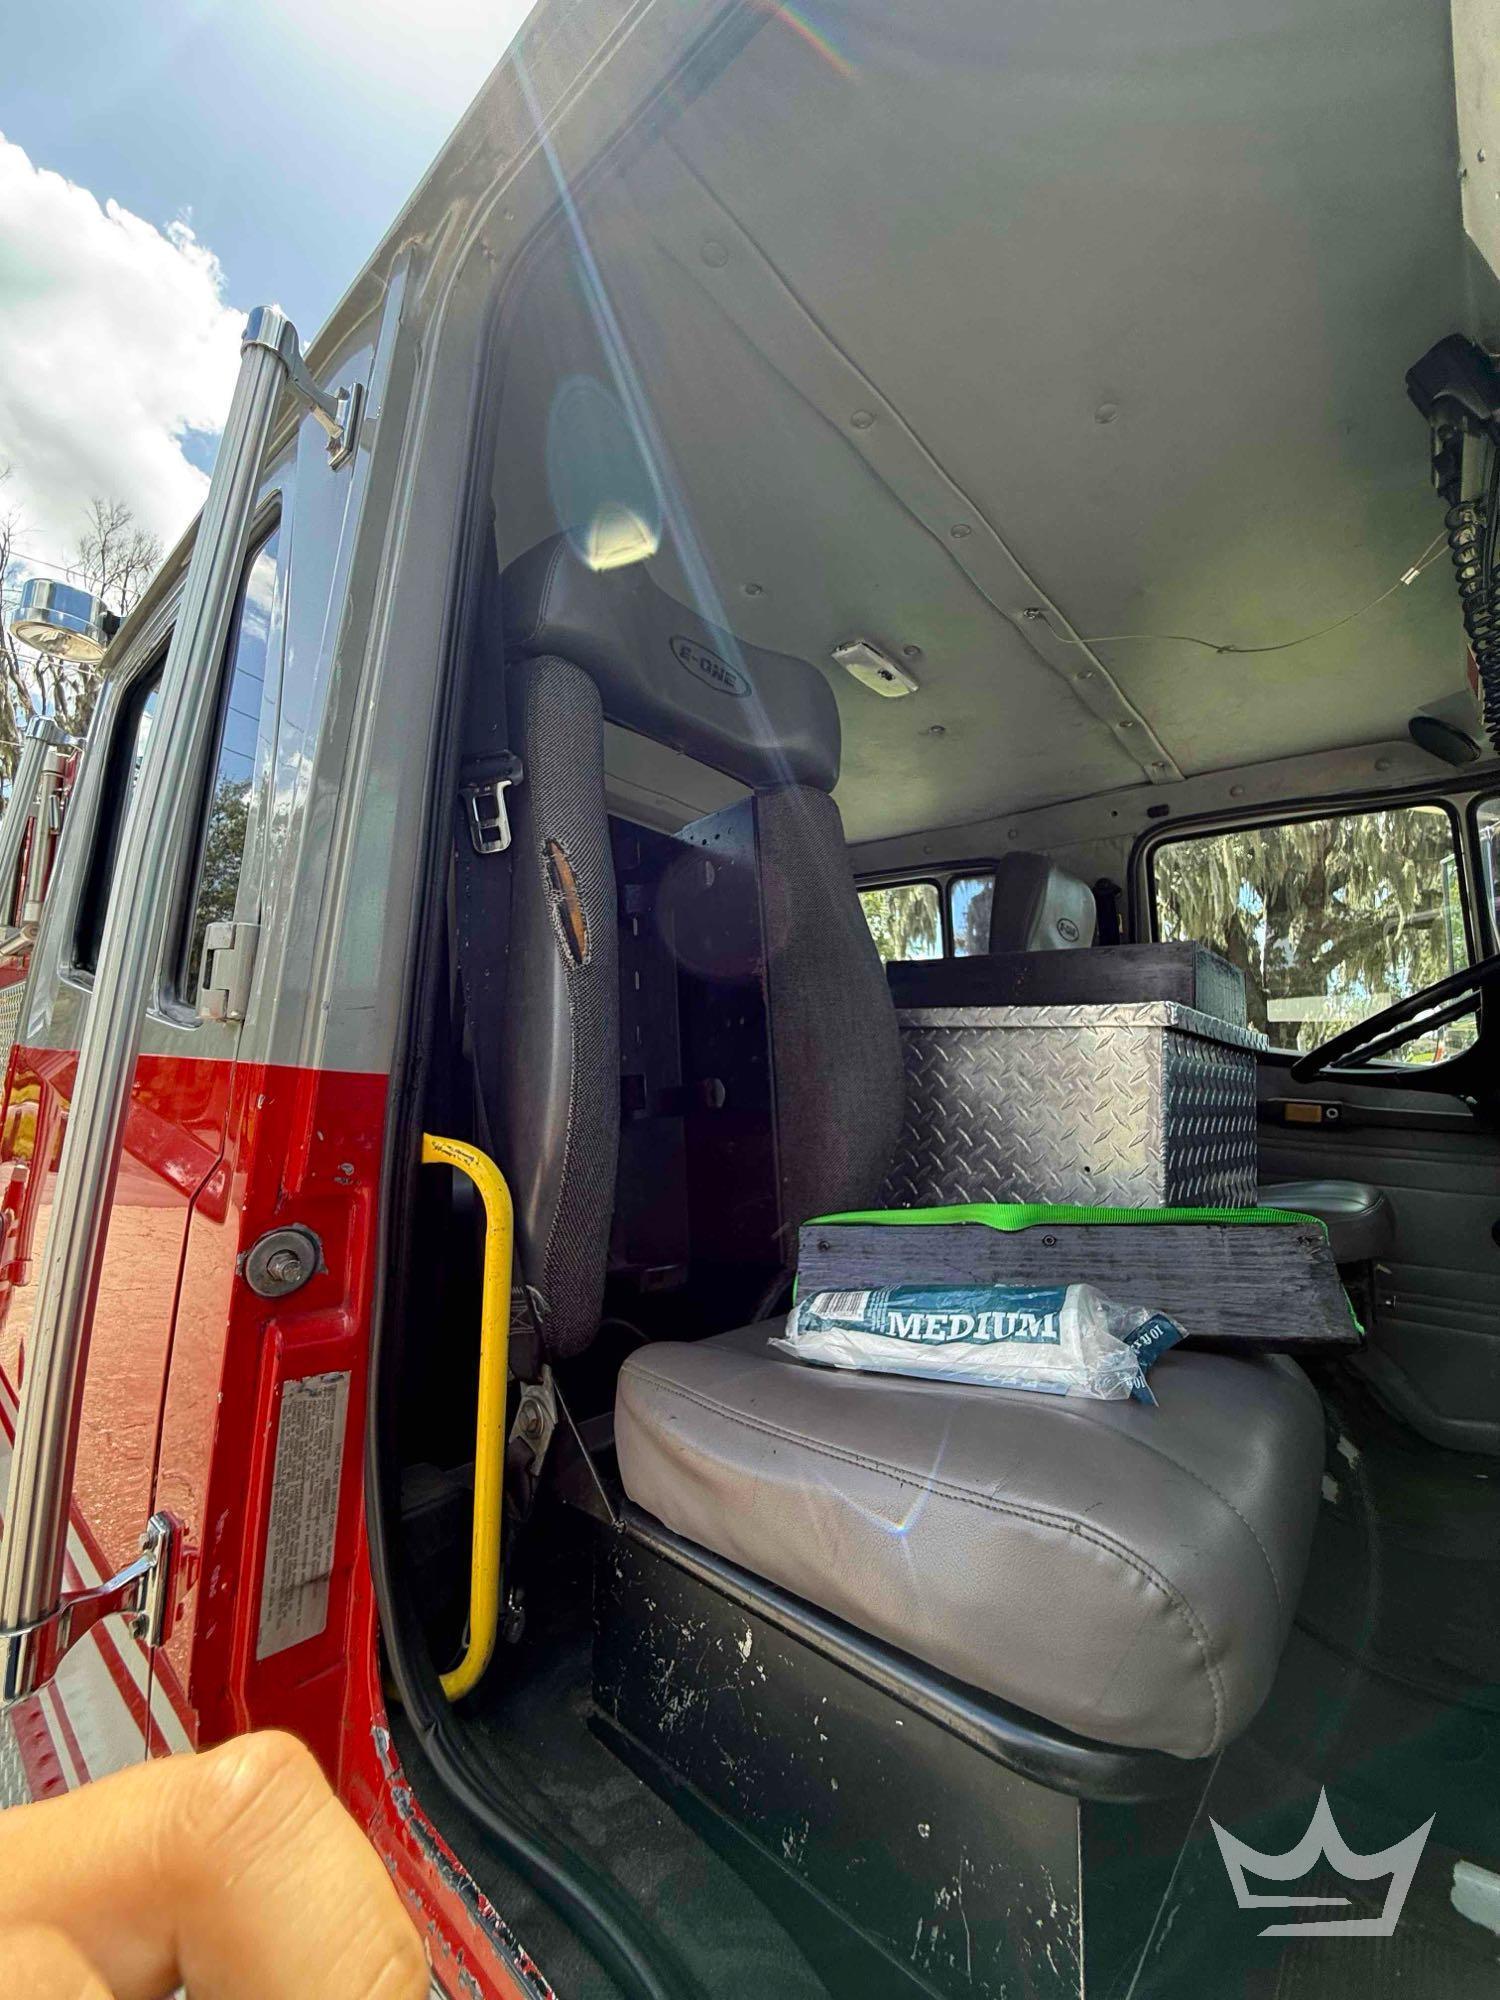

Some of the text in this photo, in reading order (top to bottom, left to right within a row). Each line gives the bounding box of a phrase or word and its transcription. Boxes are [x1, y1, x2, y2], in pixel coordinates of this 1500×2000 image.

[680, 646, 737, 688] E-ONE
[887, 1311, 1058, 1342] MEDIUM
[1149, 1324, 1164, 1339] 10
[1140, 1332, 1152, 1346] ft
